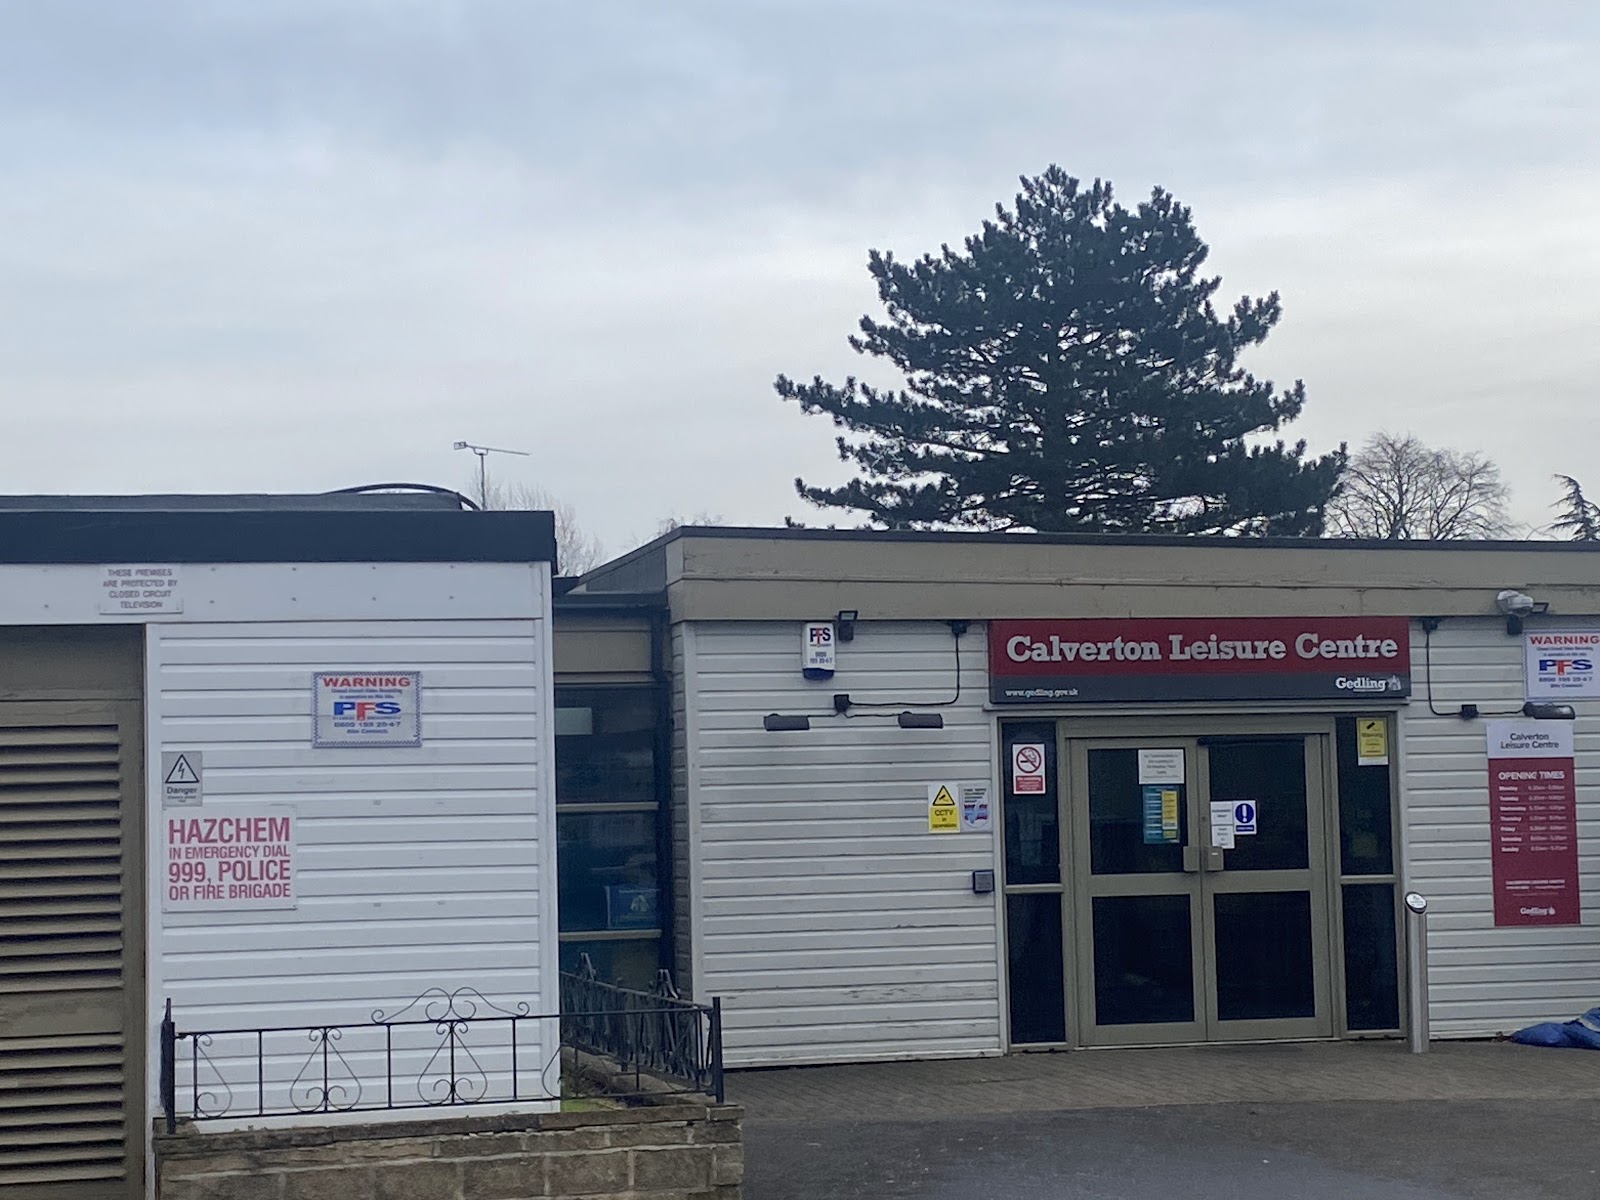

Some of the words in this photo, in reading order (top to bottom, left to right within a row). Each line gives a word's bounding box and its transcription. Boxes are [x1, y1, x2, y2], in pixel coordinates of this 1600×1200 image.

[103, 580, 118, 588] ARE
[120, 579, 165, 588] PROTECTED
[167, 579, 178, 587] BY
[108, 590, 140, 599] CLOSED
[142, 590, 171, 598] CIRCUIT
[120, 601, 163, 609] TELEVISION
[1529, 635, 1600, 645] WARNING
[1006, 635, 1162, 662] Calverton
[1168, 634, 1287, 660] Leisure
[1295, 632, 1399, 659] Centre
[1539, 659, 1593, 675] PFS
[323, 678, 411, 687] WARNING
[1335, 677, 1387, 693] Gedling
[1005, 688, 1079, 698] www.gedling.gov.uk
[334, 702, 401, 721] PFS
[1510, 733, 1549, 741] Calverton
[1500, 741, 1530, 749] Leisure
[1532, 741, 1559, 749] Centre
[1498, 771, 1537, 780] OPENING
[1539, 770, 1565, 779] TIMES
[166, 786, 198, 795] Danger
[934, 809, 954, 817] CCTV
[168, 817, 291, 845] HAZCHEM
[169, 847, 182, 860] IN
[184, 845, 260, 859] EMERGENCY
[262, 845, 291, 858] DIAL
[168, 861, 212, 886] 999,
[217, 859, 291, 882] POLICE
[168, 885, 190, 901] OR
[193, 884, 225, 900] FIRE
[228, 882, 291, 899] BRIGADE
